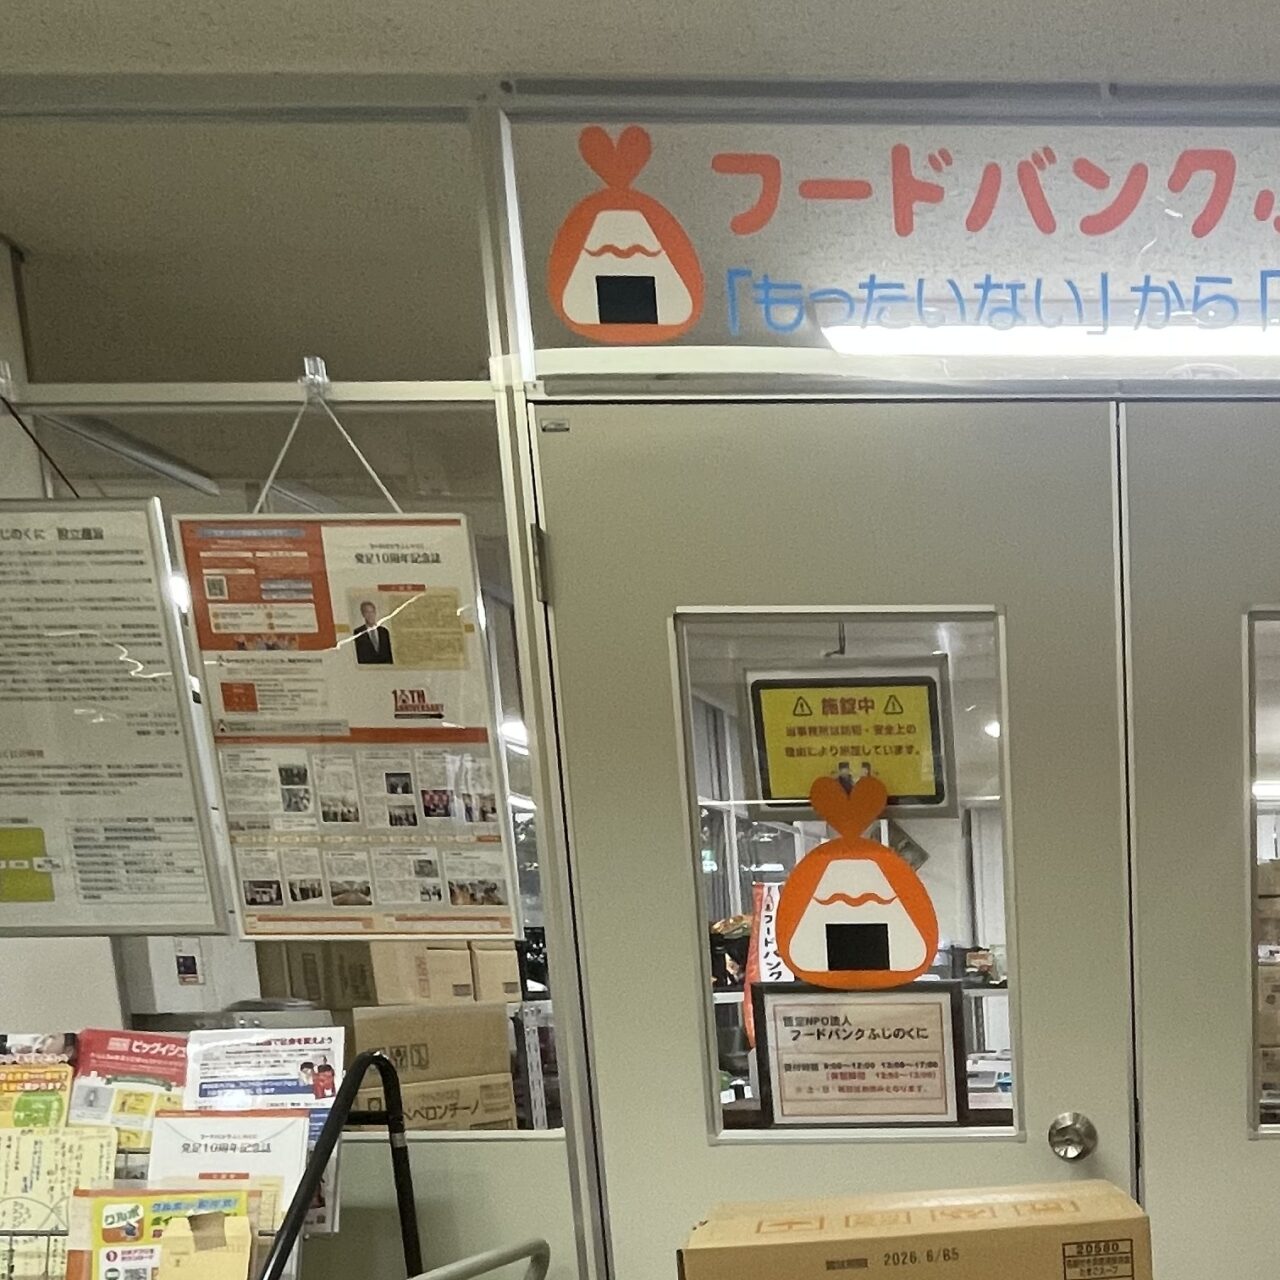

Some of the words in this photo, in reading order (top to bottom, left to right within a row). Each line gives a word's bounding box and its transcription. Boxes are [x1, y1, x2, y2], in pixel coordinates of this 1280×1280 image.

[791, 1027, 929, 1042] フードバンクふじのくに
